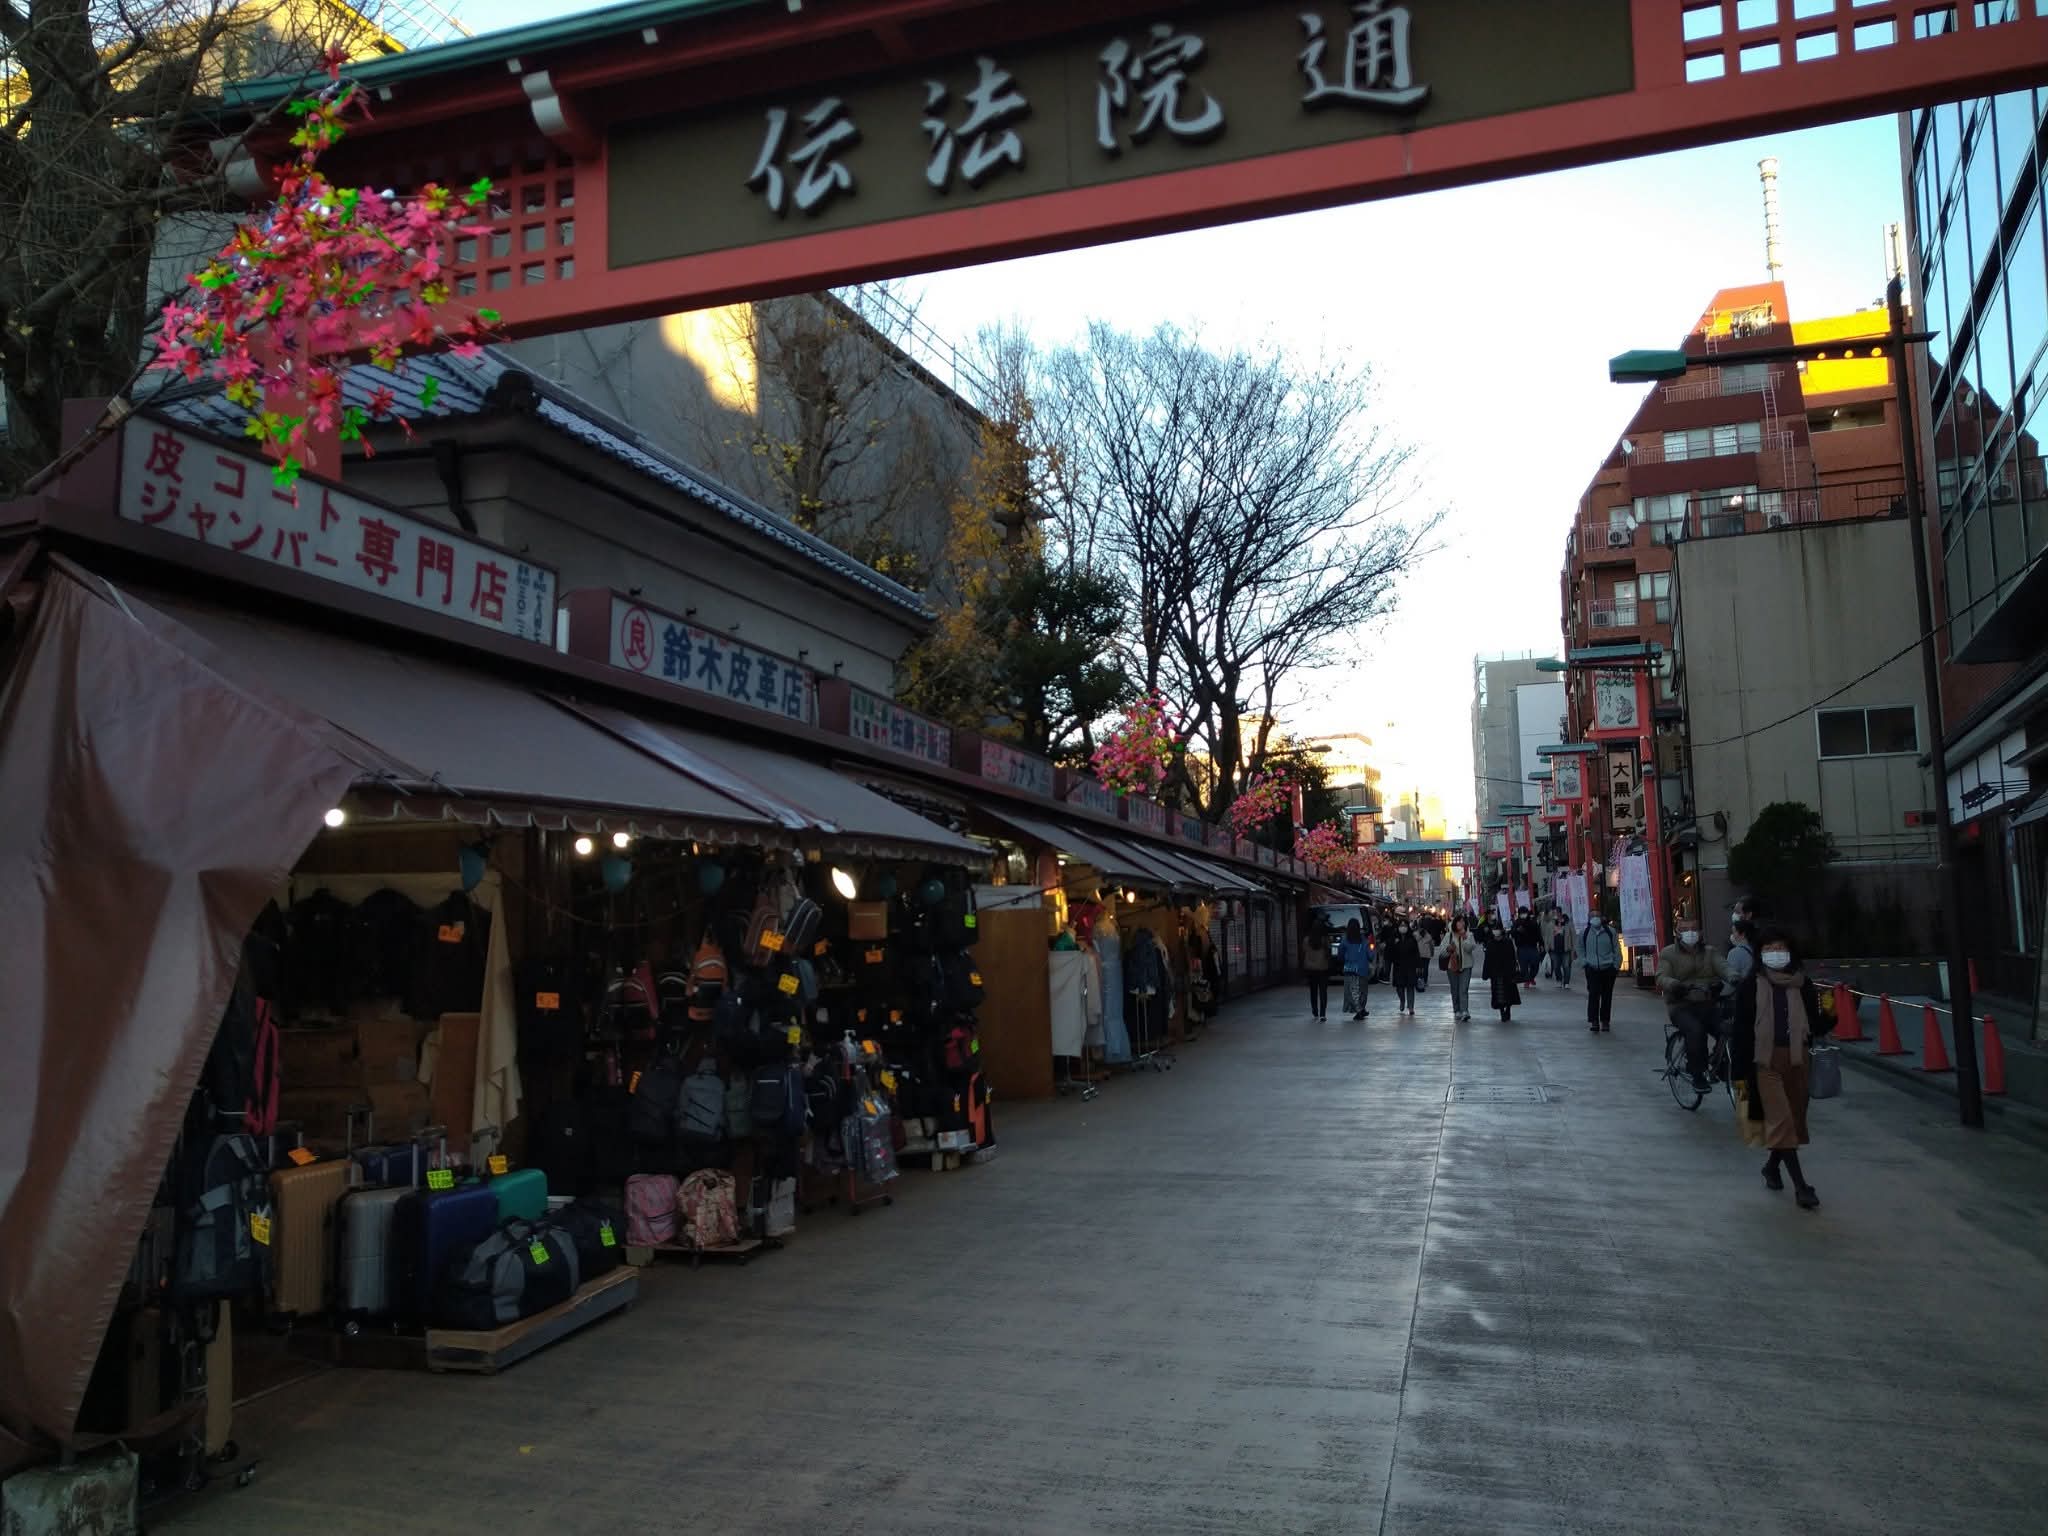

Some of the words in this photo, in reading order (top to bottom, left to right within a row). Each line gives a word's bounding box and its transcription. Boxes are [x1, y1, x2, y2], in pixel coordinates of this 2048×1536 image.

[749, 2, 1429, 214] 伝法院通
[140, 480, 338, 569] ジャンバー
[143, 430, 340, 533] 皮コート
[354, 516, 509, 624] 専門店
[662, 622, 803, 717] 鈴木皮革店
[1613, 761, 1632, 819] 大黒家
